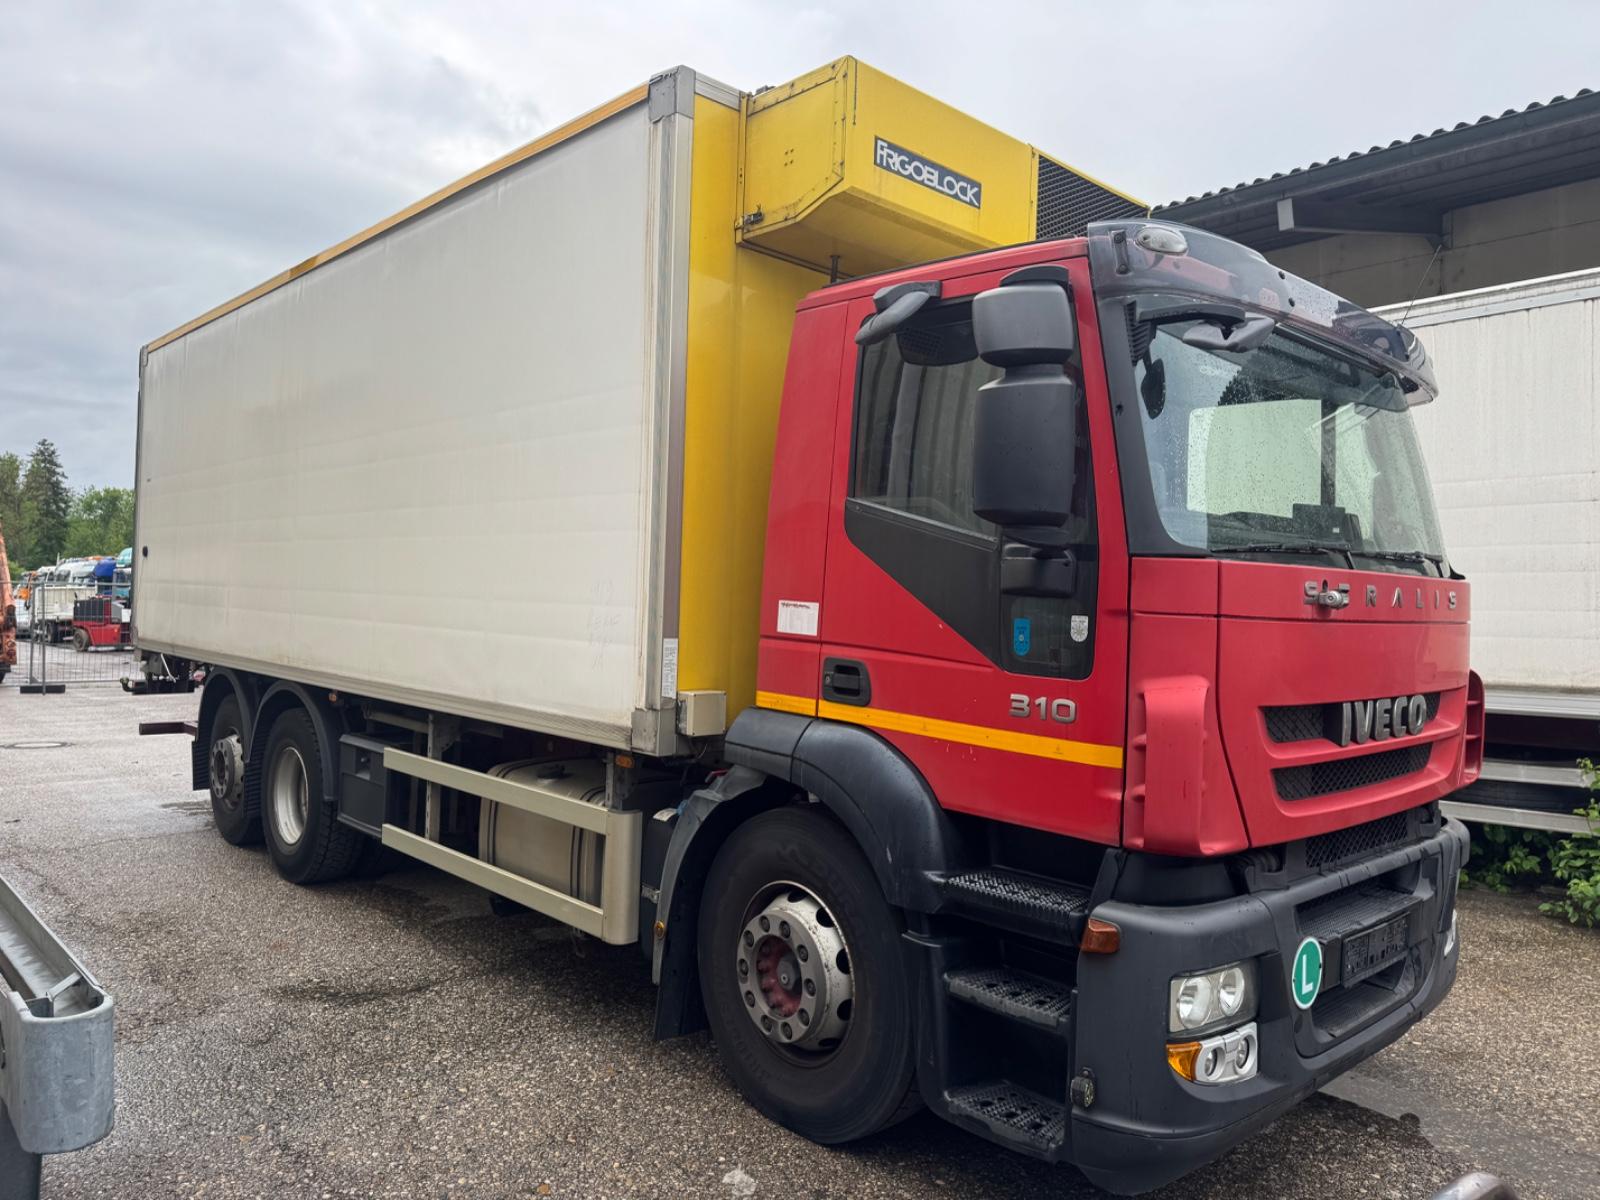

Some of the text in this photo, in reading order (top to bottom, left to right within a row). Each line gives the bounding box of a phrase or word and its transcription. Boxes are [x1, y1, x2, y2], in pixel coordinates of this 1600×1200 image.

[876, 139, 980, 207] FRIGOBLOCK
[1009, 693, 1076, 723] 310
[1341, 694, 1427, 747] IVECO
[1301, 954, 1313, 995] L
